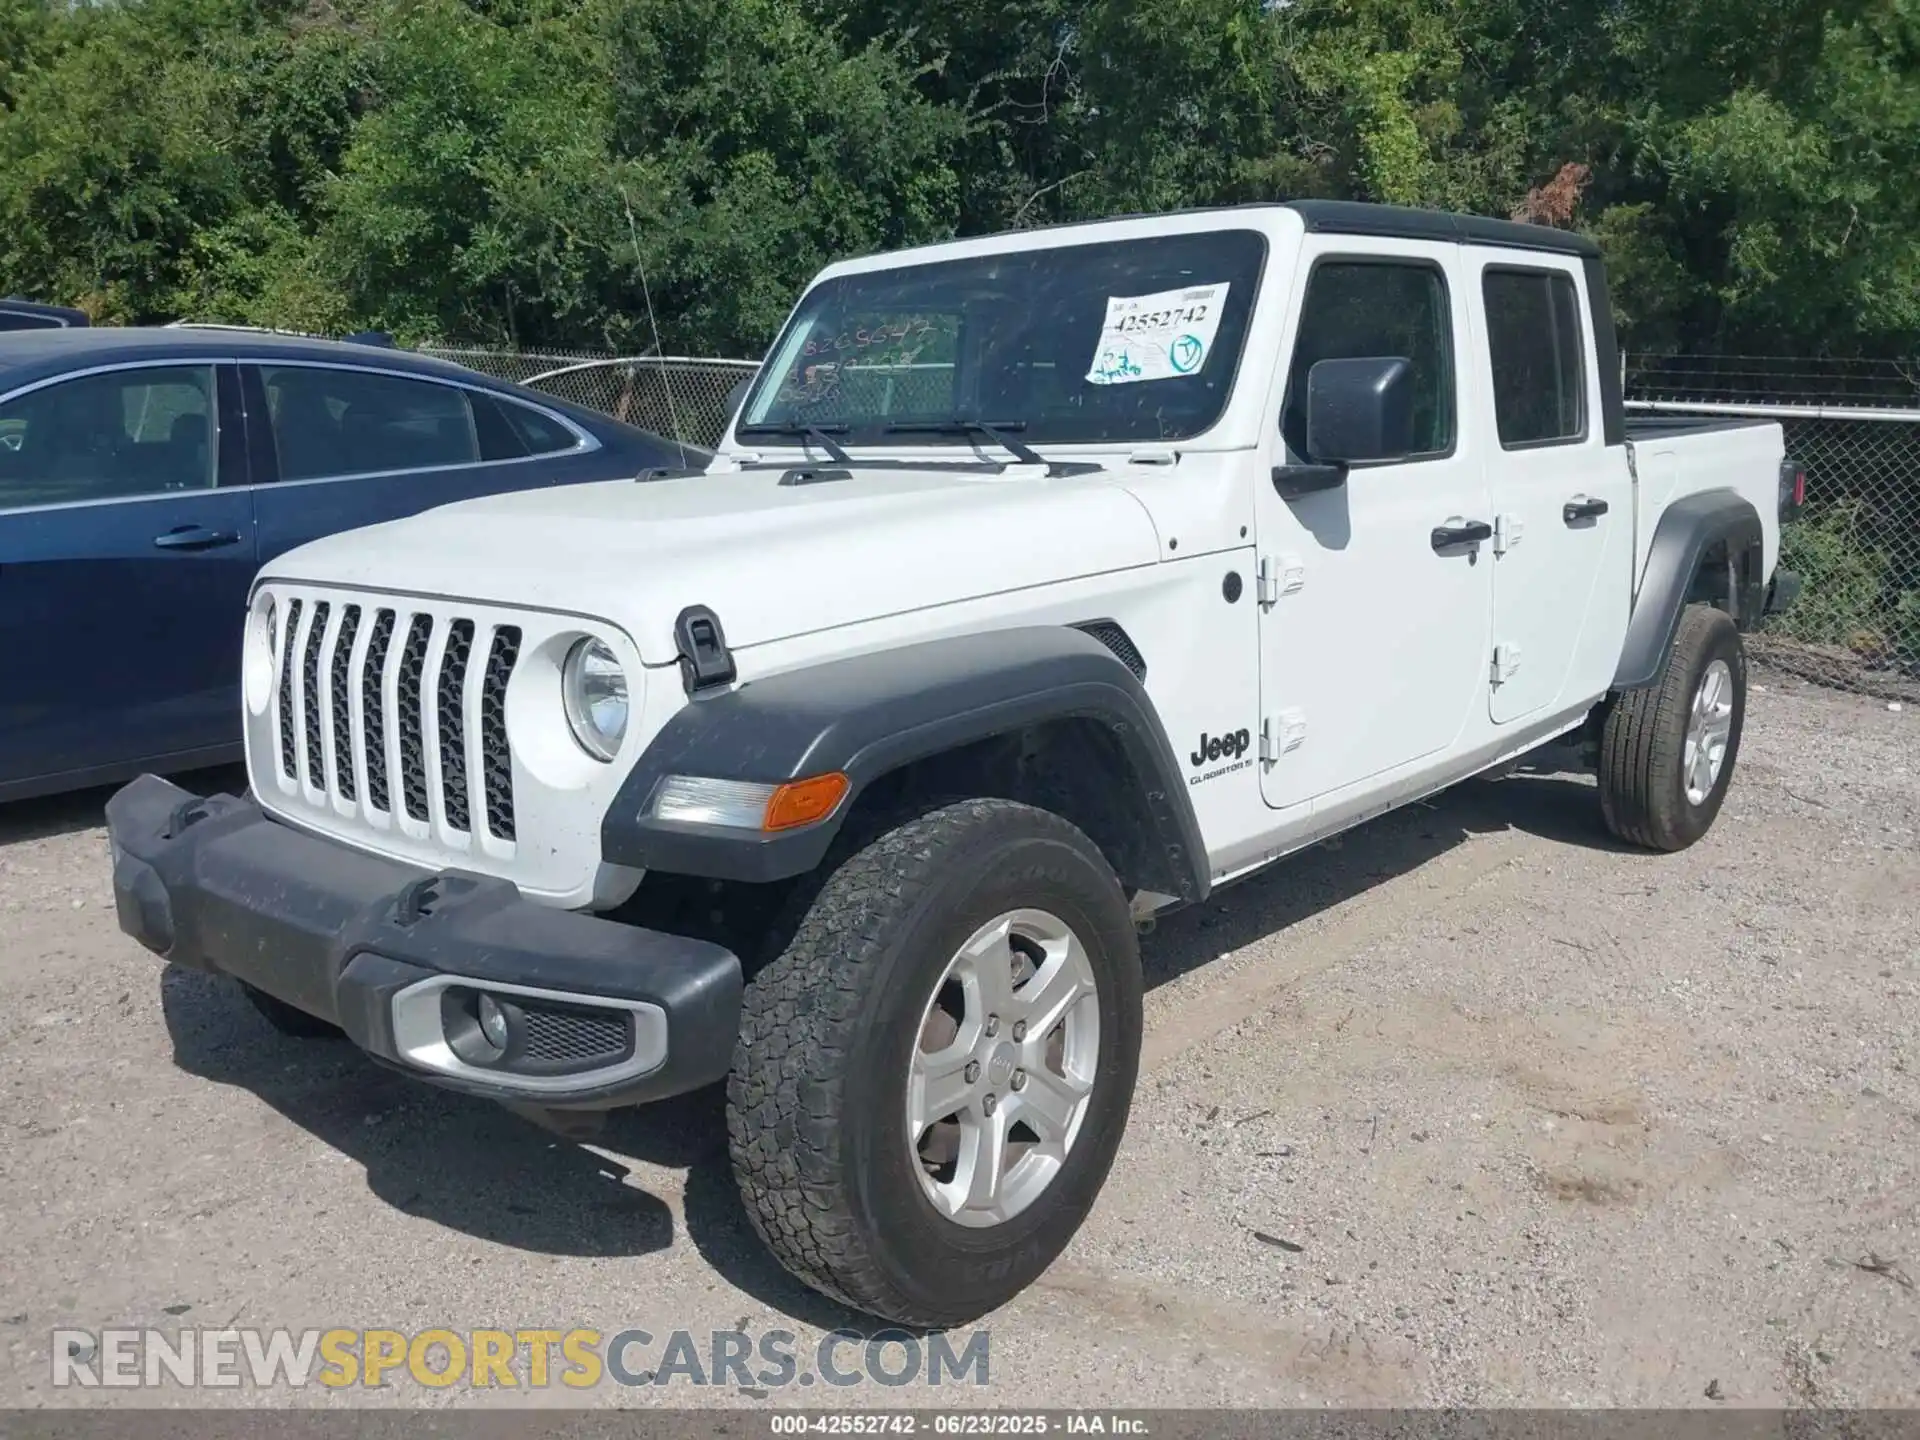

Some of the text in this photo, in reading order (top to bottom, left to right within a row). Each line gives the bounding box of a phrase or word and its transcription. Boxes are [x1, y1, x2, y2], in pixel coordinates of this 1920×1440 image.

[1114, 304, 1208, 333] 42552742
[1190, 728, 1250, 767] Jeep
[1190, 761, 1245, 785] GLADIATOR
